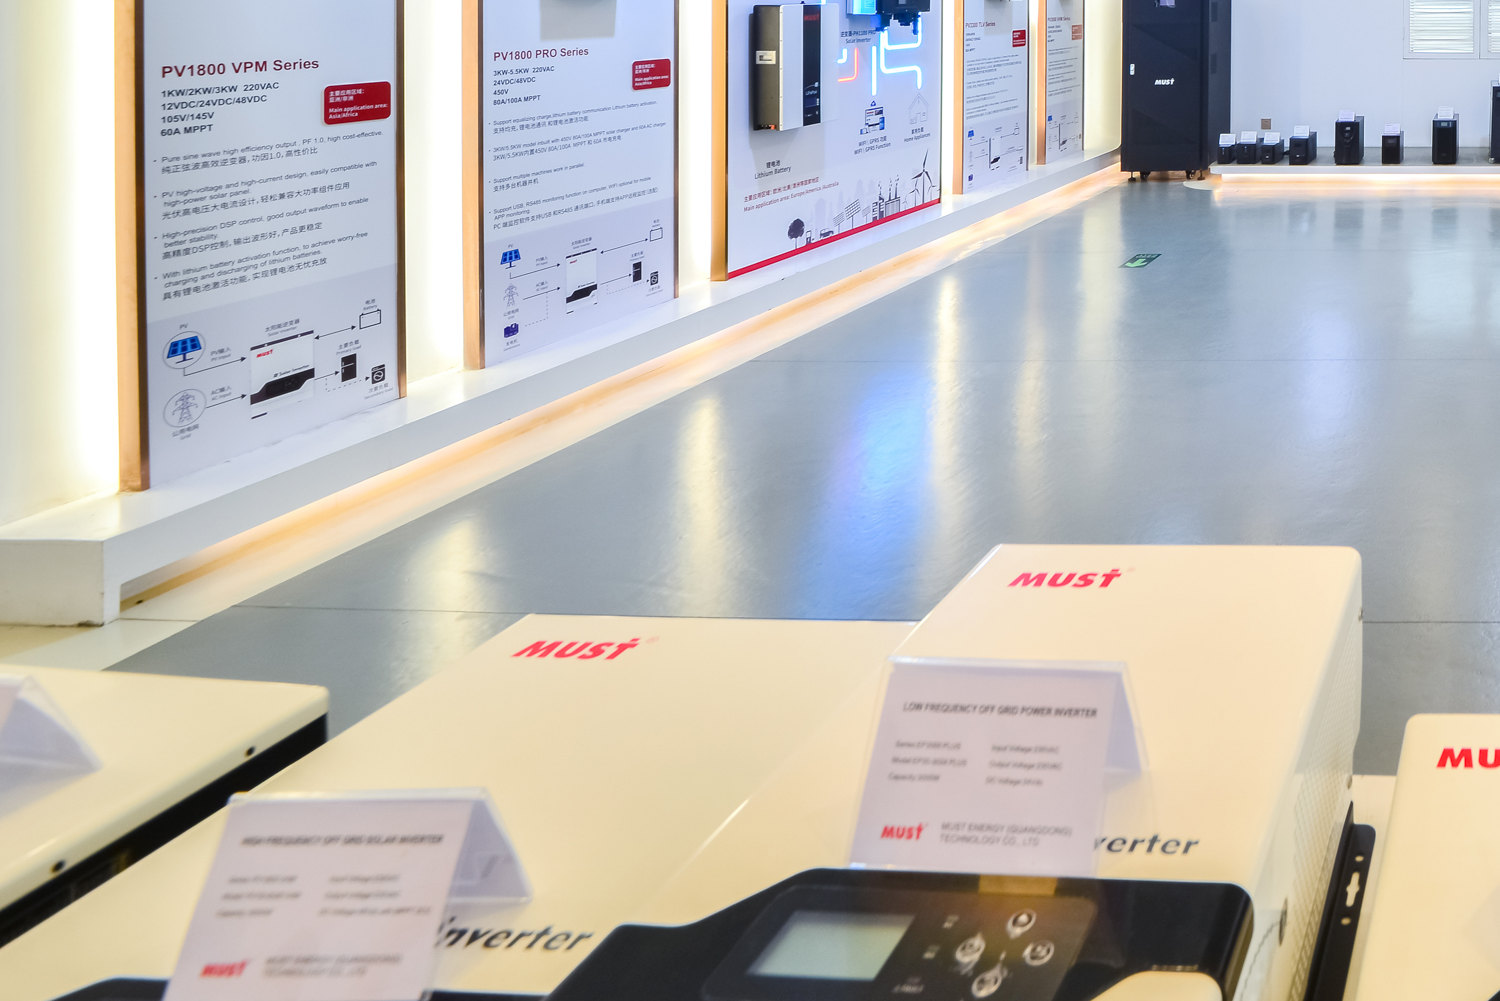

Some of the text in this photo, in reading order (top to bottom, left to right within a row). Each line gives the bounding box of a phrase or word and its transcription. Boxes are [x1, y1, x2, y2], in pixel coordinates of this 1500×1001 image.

[494, 48, 589, 62] PV1800 PRO Series
[162, 60, 319, 78] PV1800 VPM Series
[494, 68, 529, 76] 3KW-5.5KW
[493, 77, 536, 86] 24VDC/48VDC
[1155, 77, 1174, 86] MUST
[162, 82, 279, 98] 1KW/2KW/3KW 220VAC
[162, 95, 267, 111] 12VDC/24VDC/48VDC
[493, 96, 522, 105] 80A/100A
[162, 112, 214, 123] 105V/145V
[161, 125, 213, 137] 60A MPPT
[755, 165, 791, 179] Lithium Battery
[1007, 568, 1122, 589] MUST
[511, 638, 639, 660] MUST
[881, 823, 924, 840] MUST
